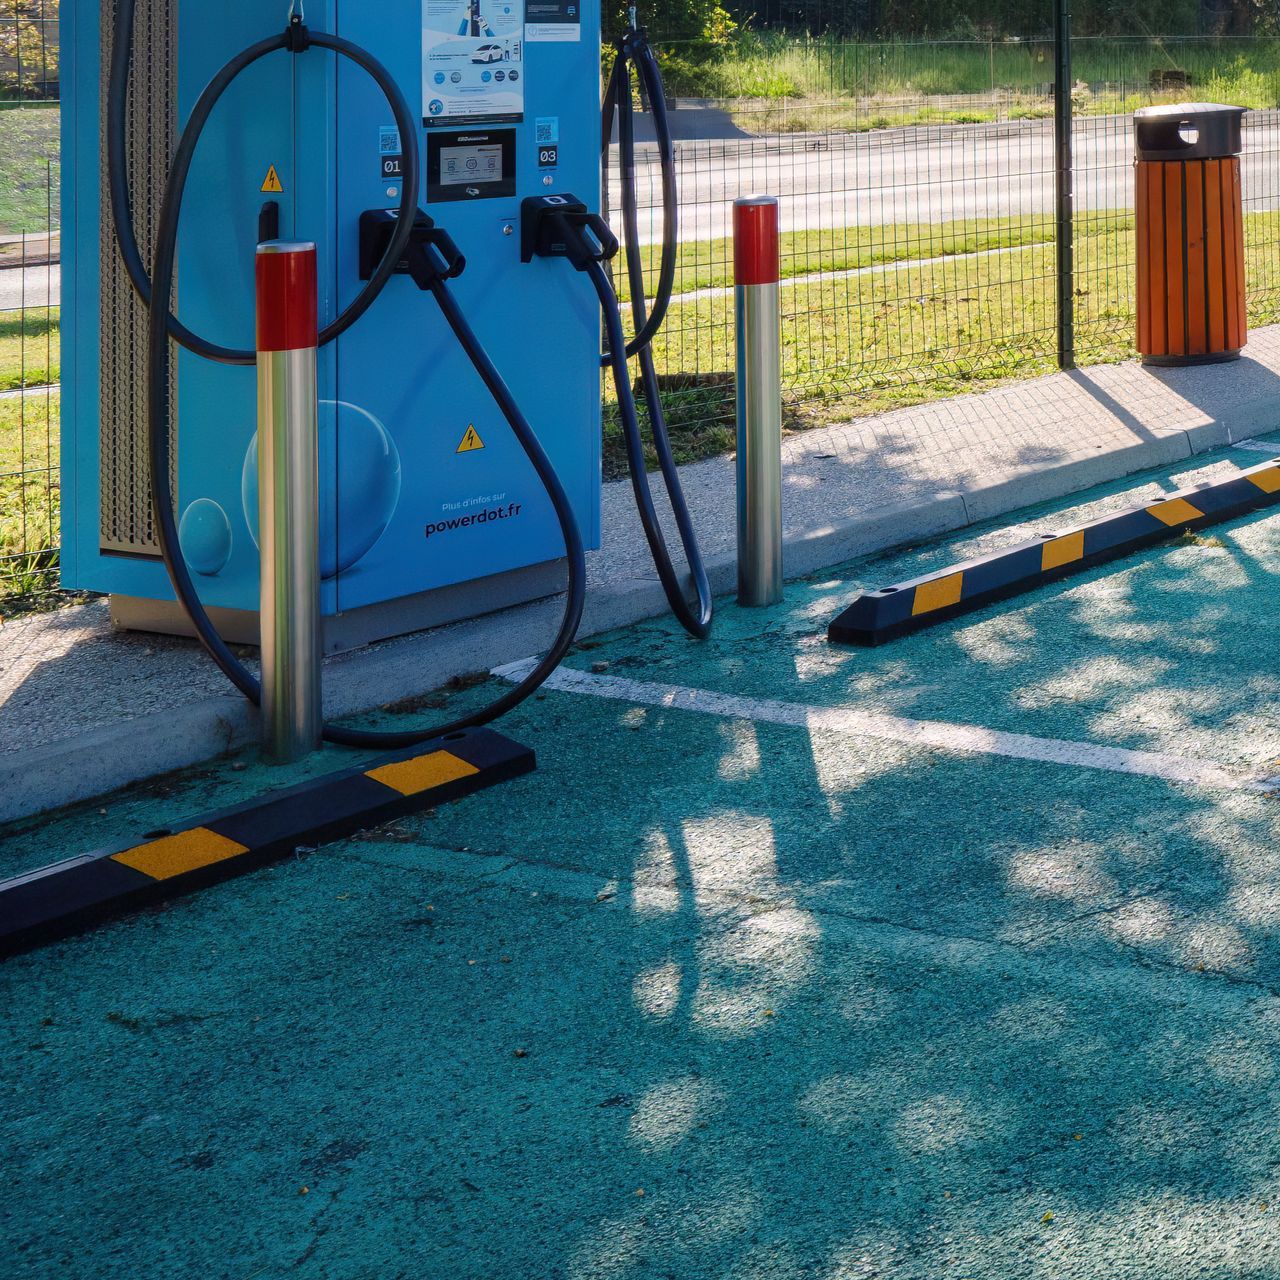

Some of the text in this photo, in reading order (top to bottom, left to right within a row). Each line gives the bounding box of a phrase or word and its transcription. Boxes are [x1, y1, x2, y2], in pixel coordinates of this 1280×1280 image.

[540, 150, 556, 162] 03
[383, 160, 400, 173] 01
[442, 501, 461, 511] Plus
[492, 492, 506, 501] sur
[425, 503, 522, 538] powerdot.fr
